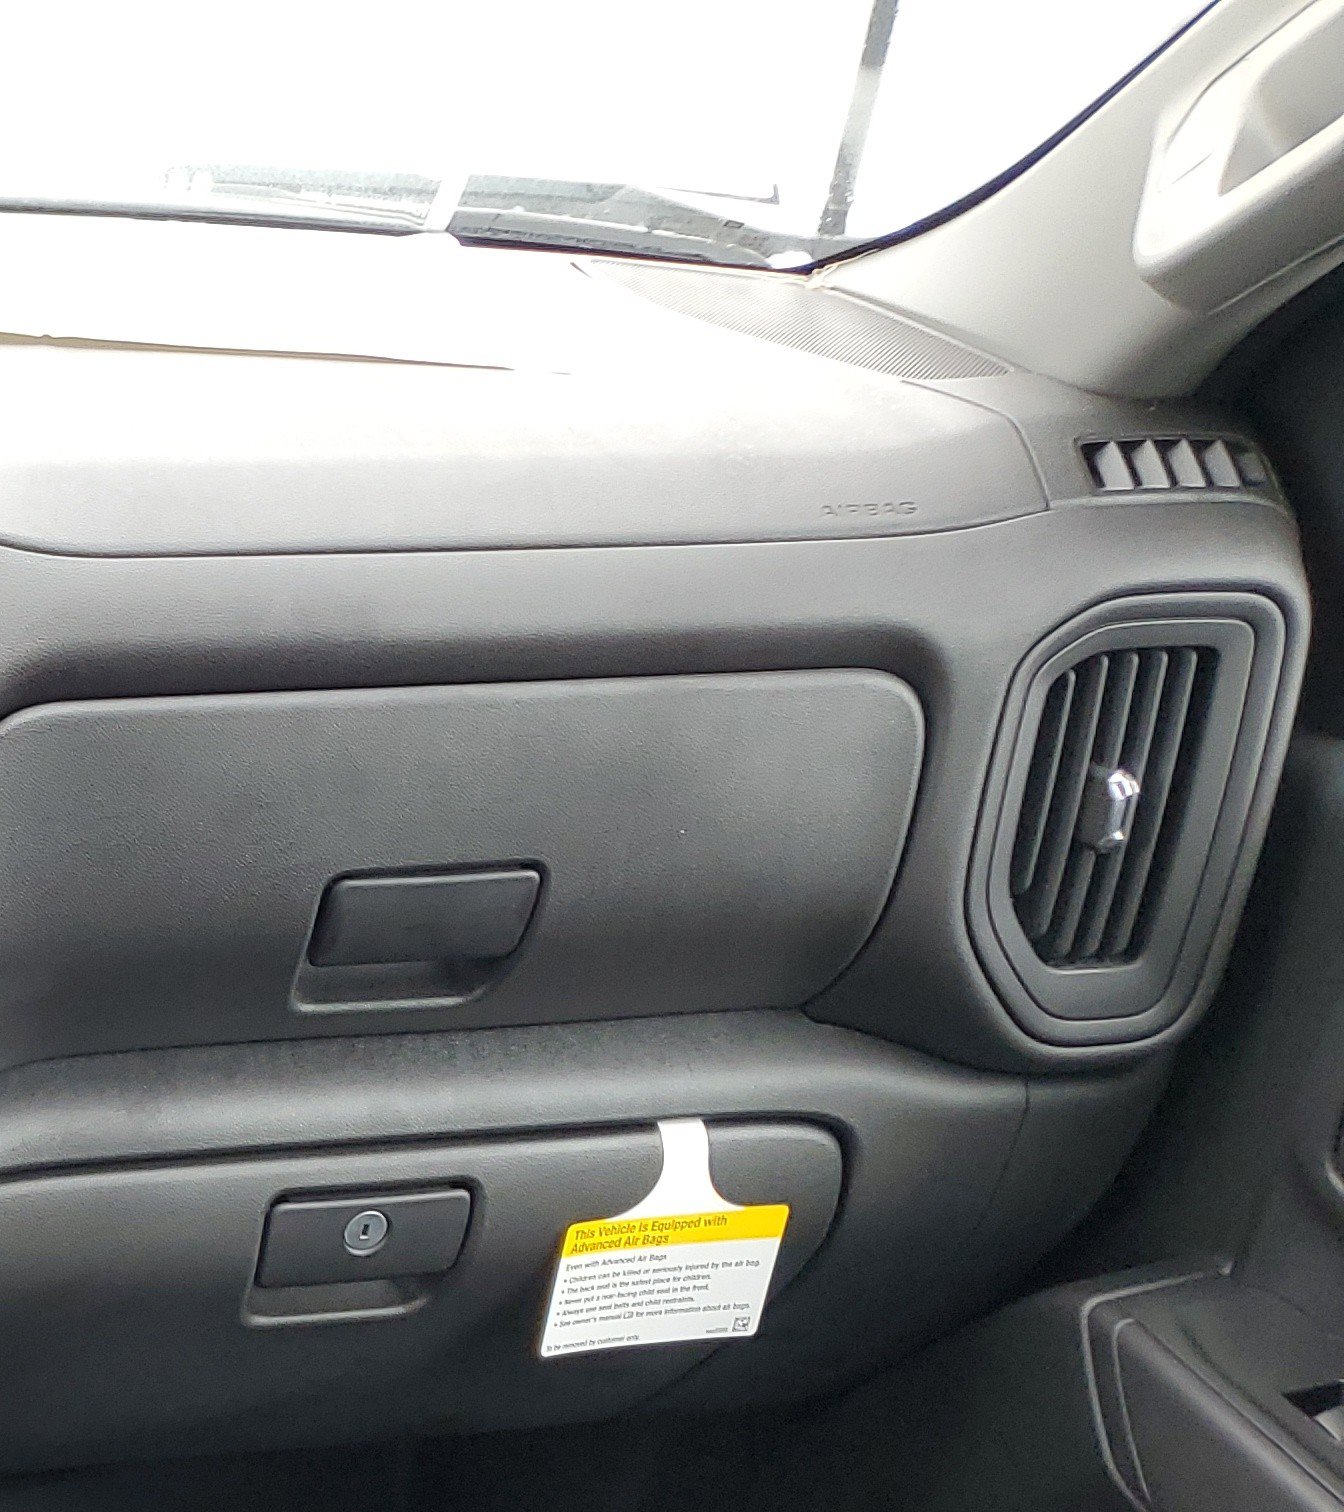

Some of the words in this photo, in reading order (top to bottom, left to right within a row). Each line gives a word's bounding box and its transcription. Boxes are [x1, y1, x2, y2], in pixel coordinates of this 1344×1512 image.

[575, 1230, 595, 1240] This
[599, 1224, 636, 1237] Vehicle
[652, 1217, 701, 1232] Equipped
[704, 1215, 728, 1227] with
[571, 1238, 621, 1254] Advanced
[624, 1236, 640, 1248] Air
[642, 1234, 669, 1246] Bags
[601, 1256, 636, 1266] Advanced
